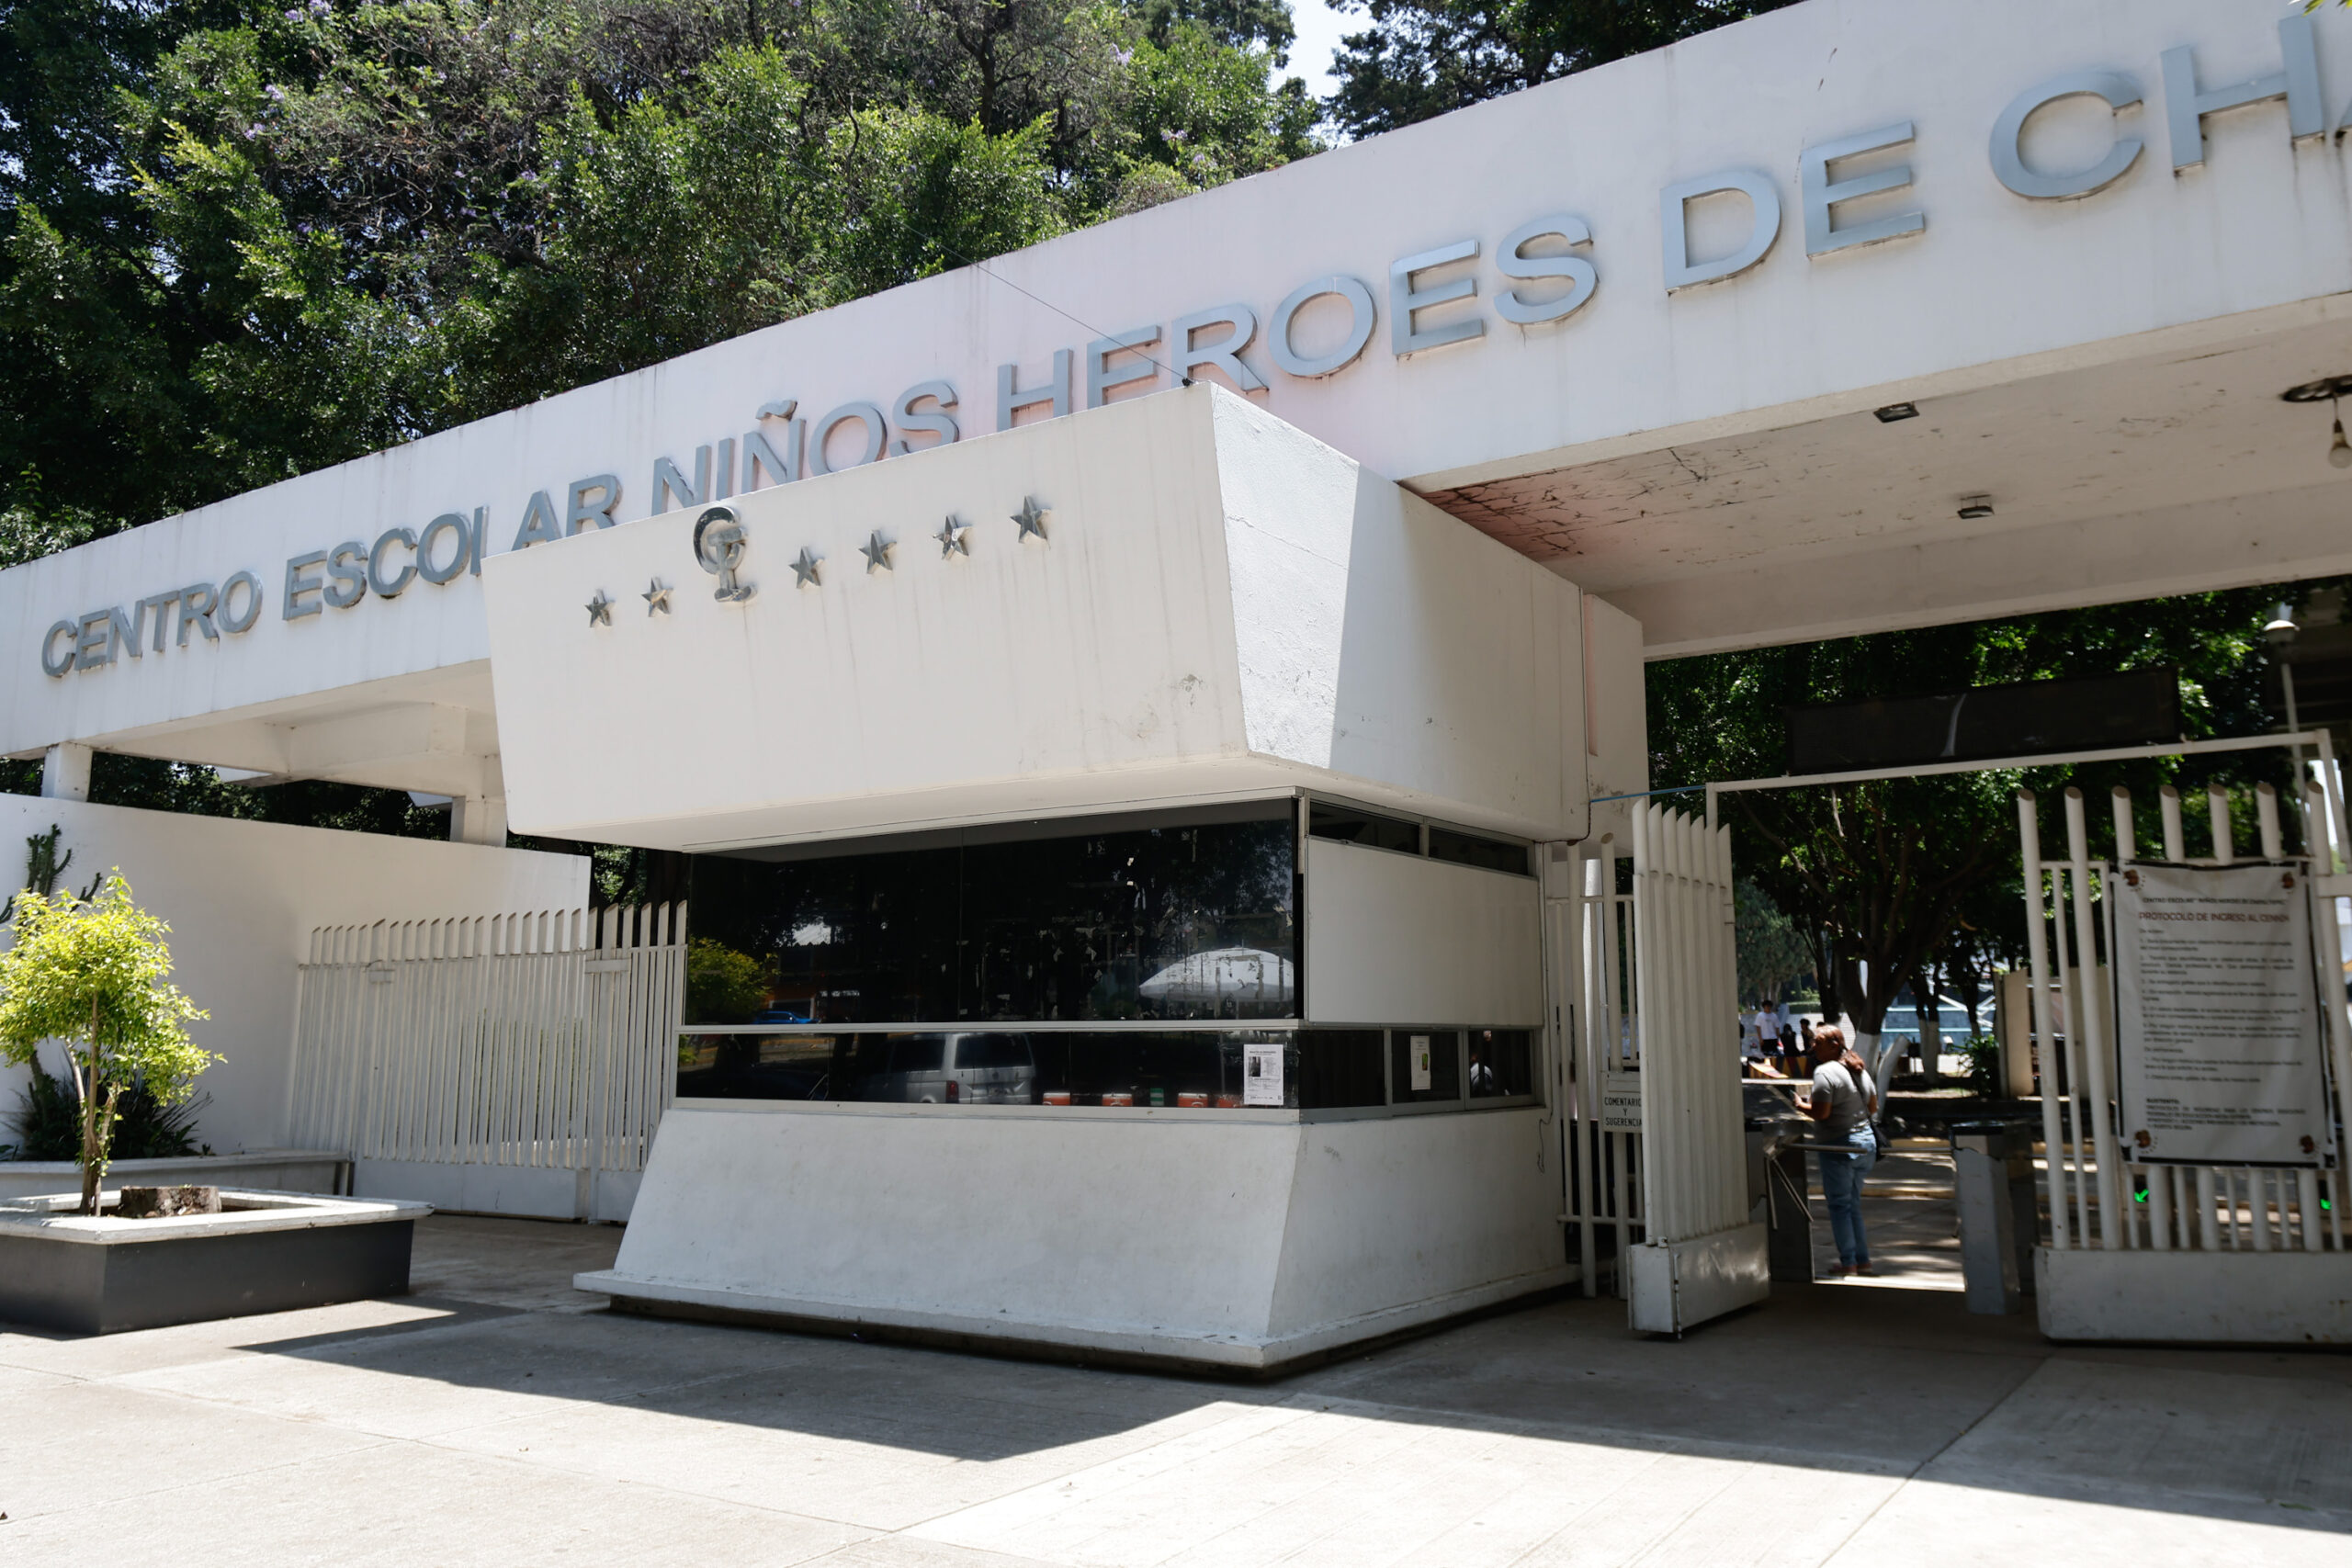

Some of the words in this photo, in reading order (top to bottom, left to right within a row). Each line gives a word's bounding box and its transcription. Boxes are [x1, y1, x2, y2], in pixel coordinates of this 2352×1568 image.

[41, 570, 264, 678] CENTRO
[651, 379, 961, 516] NIÑOS
[997, 214, 1600, 433] HEROES
[1660, 120, 1927, 296] DE
[1989, 13, 2352, 201] CH
[2139, 911, 2194, 921] PROTOCOLO
[2197, 912, 2210, 921] DE
[2211, 912, 2246, 922] INGRESO
[1623, 1108, 1628, 1116] Y
